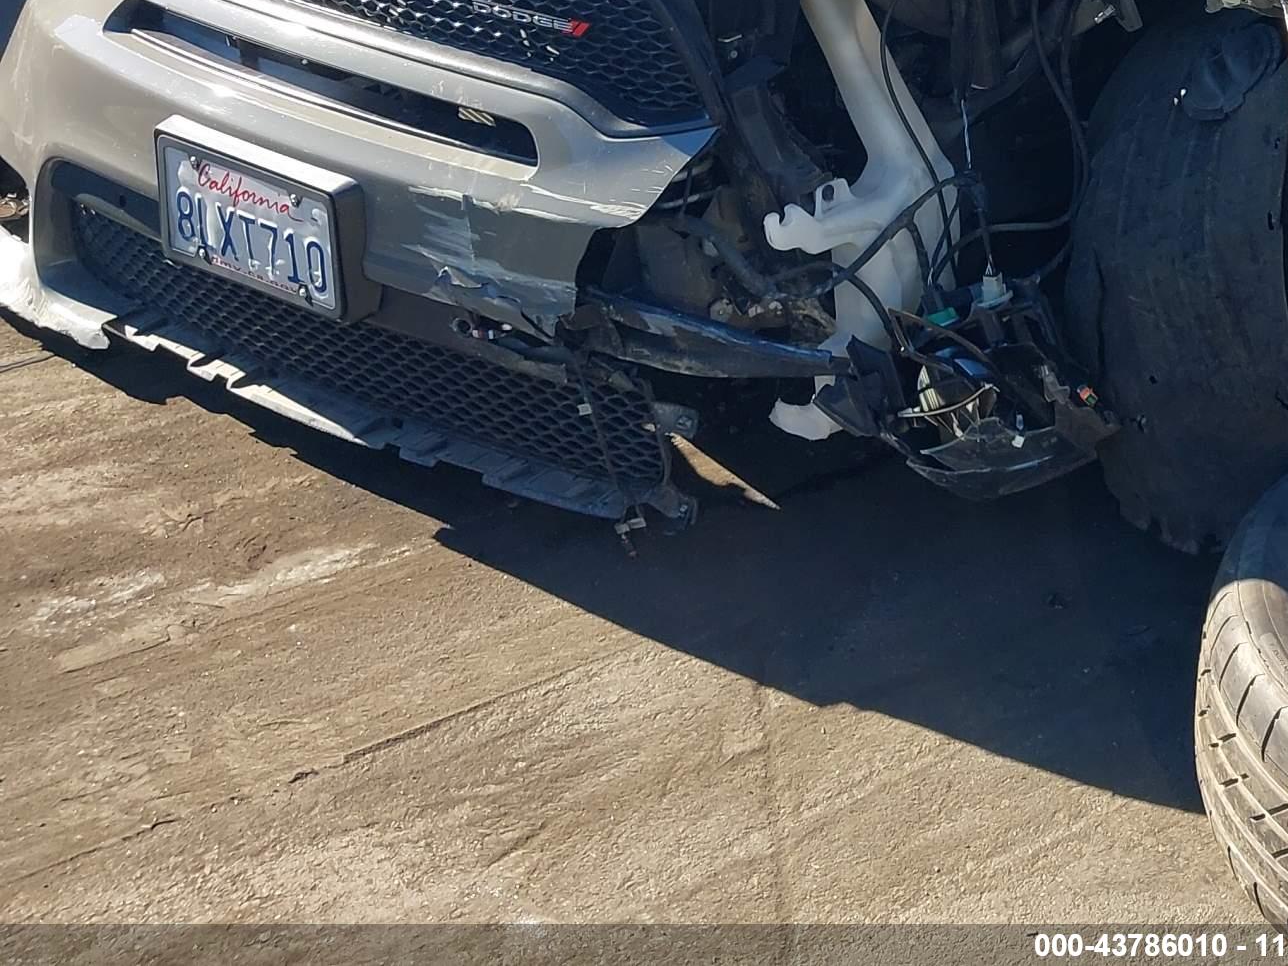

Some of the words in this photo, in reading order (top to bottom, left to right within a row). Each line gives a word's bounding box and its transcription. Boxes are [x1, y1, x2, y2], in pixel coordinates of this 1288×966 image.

[472, 0, 574, 33] DODGE
[198, 163, 304, 223] California
[176, 190, 328, 294] 8LXT710
